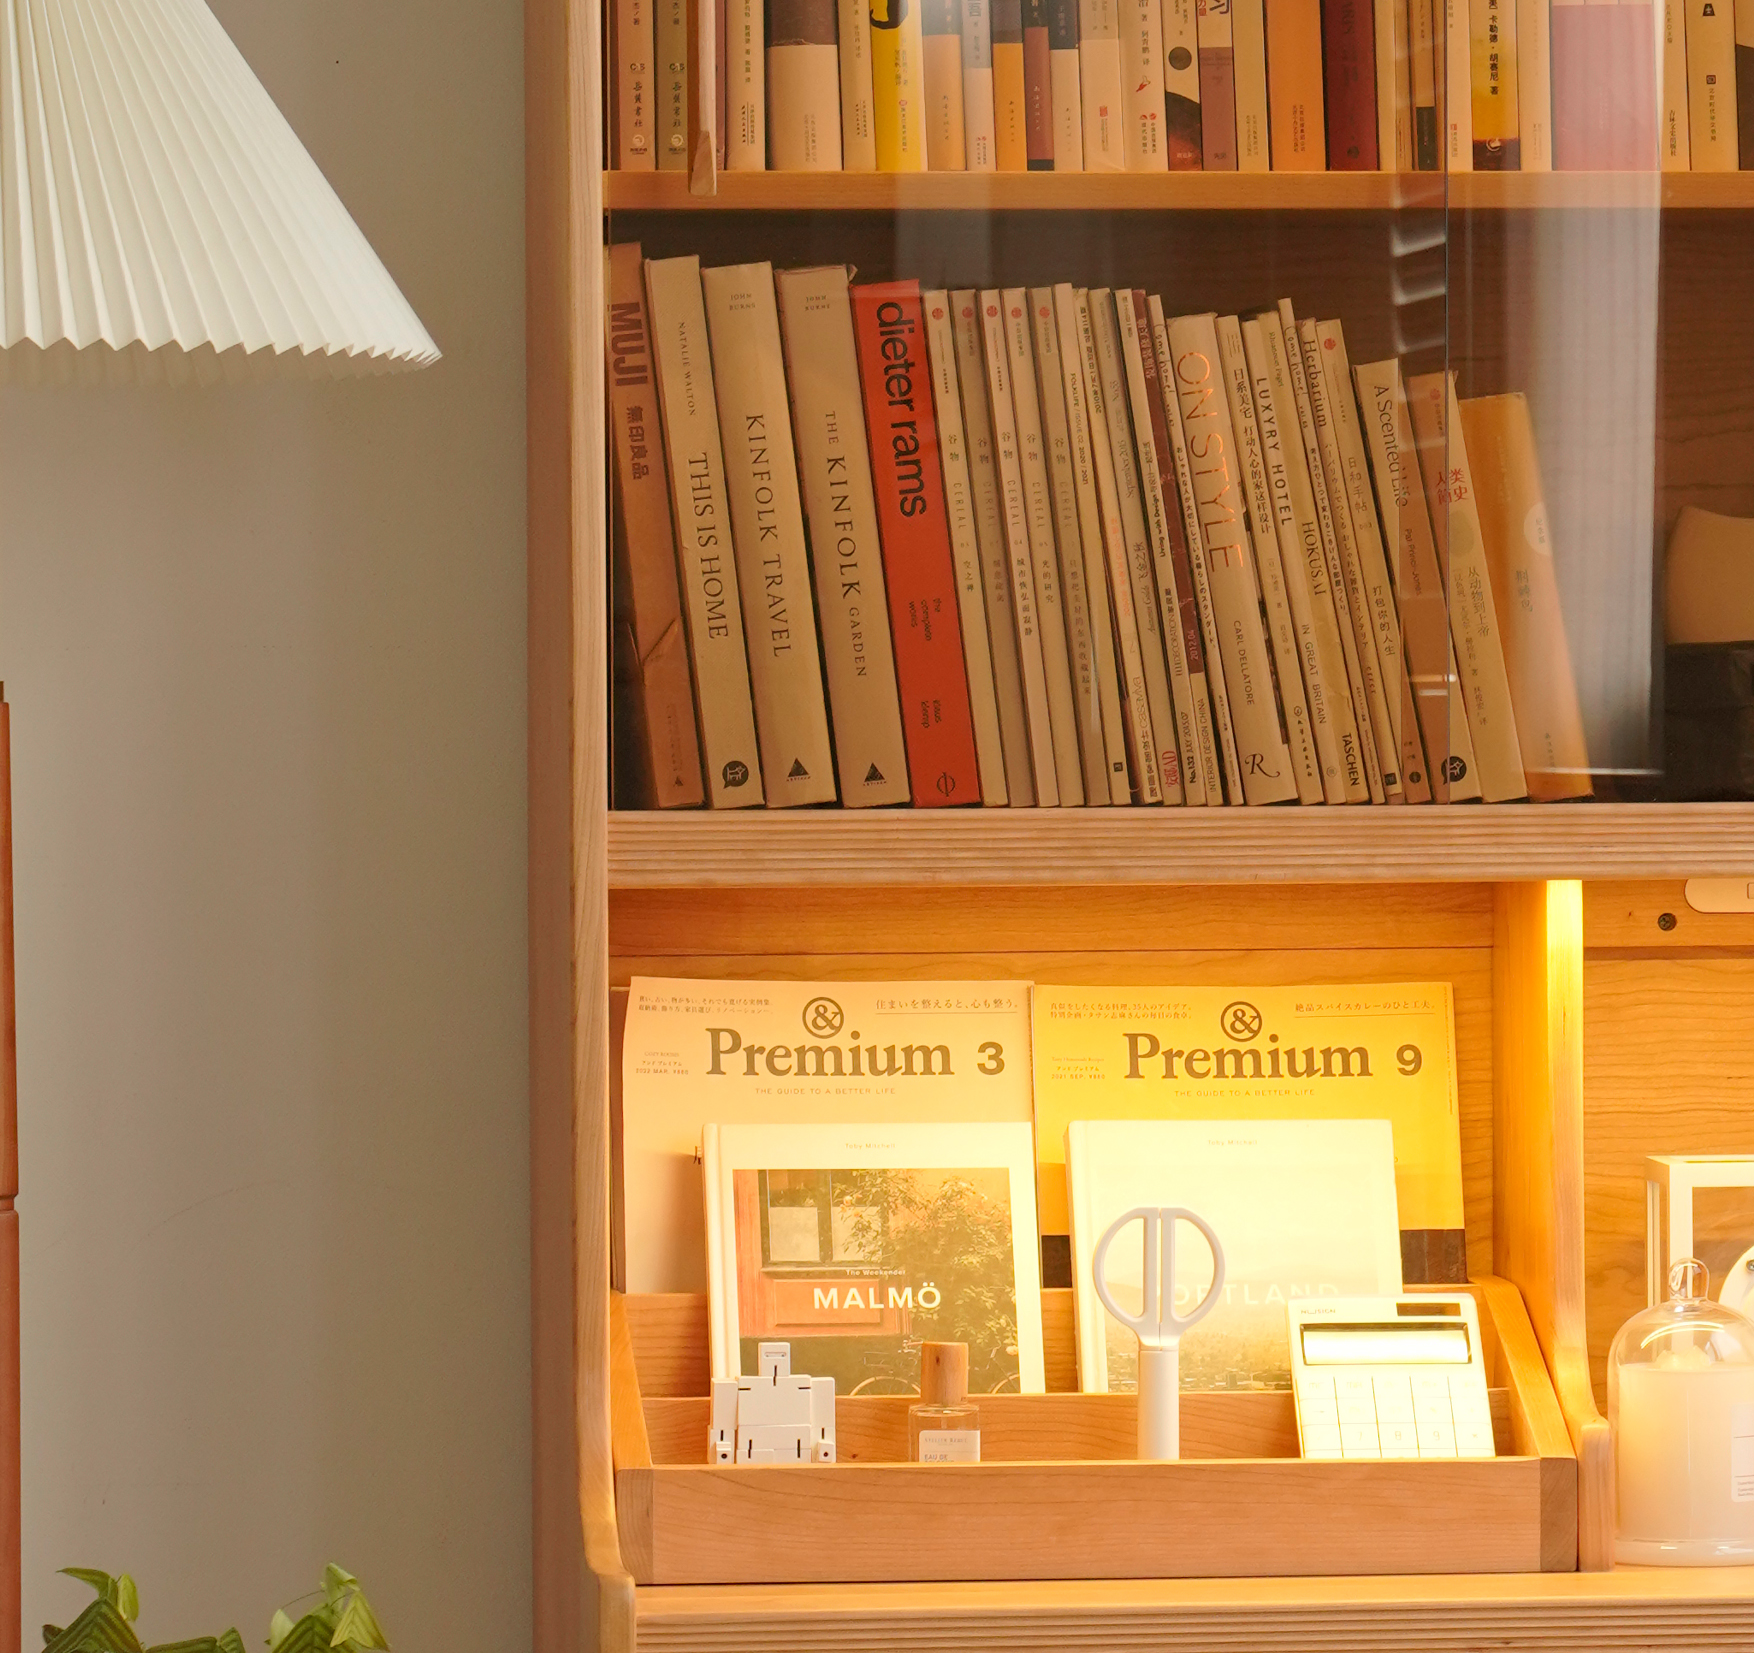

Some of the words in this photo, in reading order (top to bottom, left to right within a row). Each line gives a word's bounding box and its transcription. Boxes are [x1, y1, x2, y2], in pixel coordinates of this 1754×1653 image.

[729, 302, 756, 311] BURNS
[730, 293, 752, 301] JOHN
[805, 294, 827, 302] JOHN
[610, 301, 648, 387] MUJI
[876, 301, 915, 413] dieter
[1153, 323, 1167, 356] Come
[1284, 325, 1298, 359] Come
[1291, 361, 1309, 397] home!
[678, 321, 690, 367] NATALIE
[684, 371, 696, 416] WALTON
[1071, 372, 1080, 407] FOLKLIFE
[1158, 359, 1176, 395] home!
[1177, 351, 1217, 421] ON
[1274, 367, 1284, 388] Paget
[1303, 339, 1328, 429] Herbarium
[825, 411, 840, 445] THE
[1256, 377, 1280, 451] LUXYRY
[626, 405, 650, 480] 無印良品
[1233, 367, 1252, 419] 日系美宅
[1243, 425, 1271, 535] 打动人心的家这样设计
[688, 451, 714, 517] THIS
[890, 420, 927, 518] rams
[1122, 458, 1136, 498] September
[1348, 456, 1367, 513] 日和手帖
[1435, 468, 1465, 487] 人类
[953, 482, 967, 529] CEREAL
[983, 481, 998, 528] CEREAL
[1007, 479, 1020, 527] CEREAL
[1032, 481, 1045, 529] CEREAL
[1059, 481, 1071, 529] CEREAL
[1151, 494, 1161, 518] Design
[1190, 431, 1243, 574] STYLE
[1271, 464, 1293, 526] HOTEL
[1436, 484, 1469, 506] 简史
[696, 524, 718, 548] IS
[745, 413, 778, 542] KINFOLK
[762, 553, 792, 658] TRAVEL
[826, 455, 861, 600] KINFOLK
[1154, 519, 1162, 535] with
[1302, 520, 1327, 596] HOKUSAI
[700, 555, 729, 639] HOME
[909, 601, 918, 628] works
[921, 599, 932, 642] complete
[933, 597, 942, 613] the
[1372, 585, 1396, 656] 打包你的人生
[1467, 566, 1491, 637] 从动物到上帝
[849, 606, 867, 677] GARDEN
[1187, 629, 1199, 661] 2012.04
[1233, 620, 1244, 648] CARL
[1301, 623, 1310, 635] IN
[1238, 649, 1255, 706] DELLATORE
[1304, 641, 1319, 676] GREAT
[1131, 675, 1148, 729] casaviva
[1197, 697, 1207, 724] CHINA
[1312, 683, 1327, 724] BRITAIN
[1201, 725, 1211, 754] DESIGN
[1342, 732, 1360, 787] TASCHEN
[1205, 756, 1216, 793] INTERIOR
[875, 998, 1018, 1010] 住まいを整えると、心も整う。
[705, 1028, 955, 1077] Premium
[977, 1041, 1005, 1075] 3
[1122, 1033, 1373, 1079] Premium
[1396, 1044, 1423, 1076] 9
[1254, 1089, 1291, 1097] BETTER
[813, 1282, 941, 1309] MALMÖ
